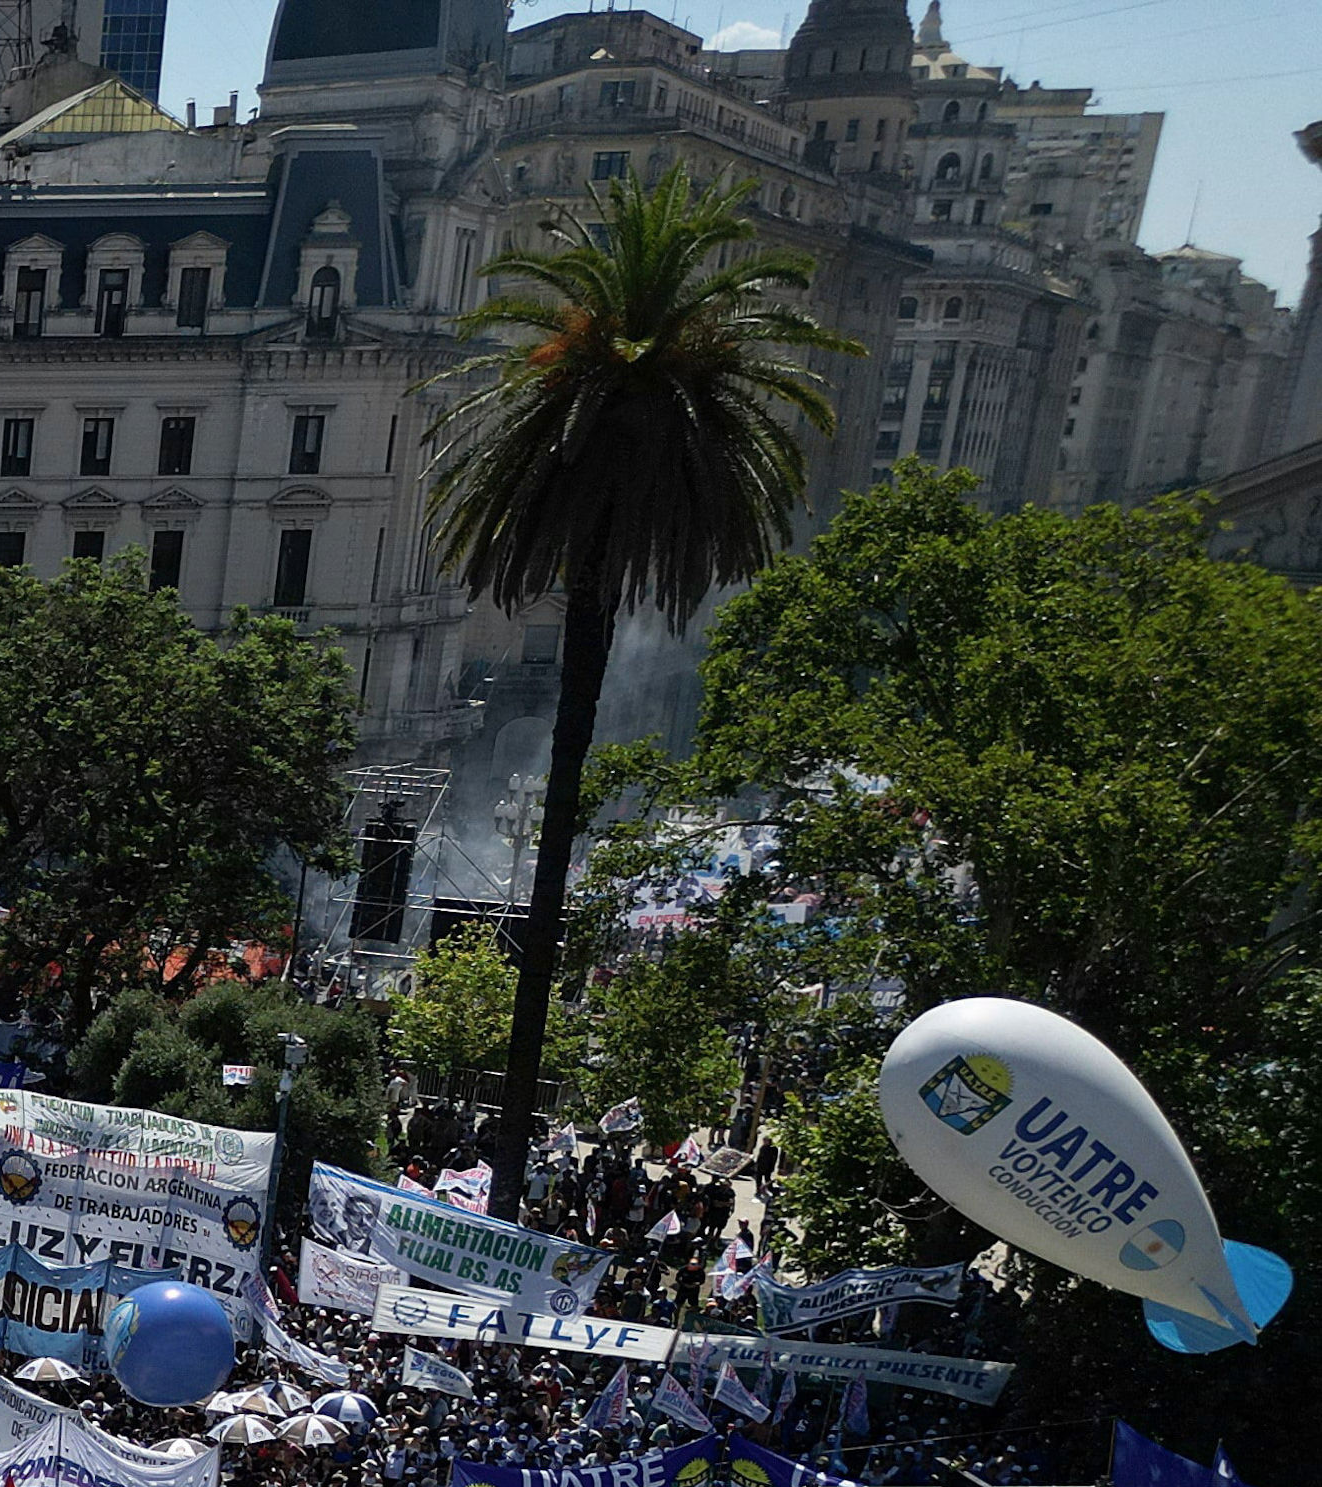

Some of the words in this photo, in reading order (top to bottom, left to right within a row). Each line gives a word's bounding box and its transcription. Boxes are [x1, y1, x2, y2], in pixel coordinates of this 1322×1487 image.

[45, 1162, 147, 1191] FEDERACION
[154, 1177, 221, 1211] ARGENTINA
[999, 1139, 1112, 1234] VOYTENCO
[1015, 1096, 1159, 1226] UATRE
[77, 1196, 198, 1233] TRABAJADORES
[989, 1165, 1082, 1239] CONDUCCIÓN
[72, 1232, 105, 1265] Y
[385, 1203, 548, 1273] ALIMENTACIÓN
[395, 1234, 455, 1274] FILIAL
[459, 1256, 490, 1287] BS.
[495, 1267, 524, 1296] AS.
